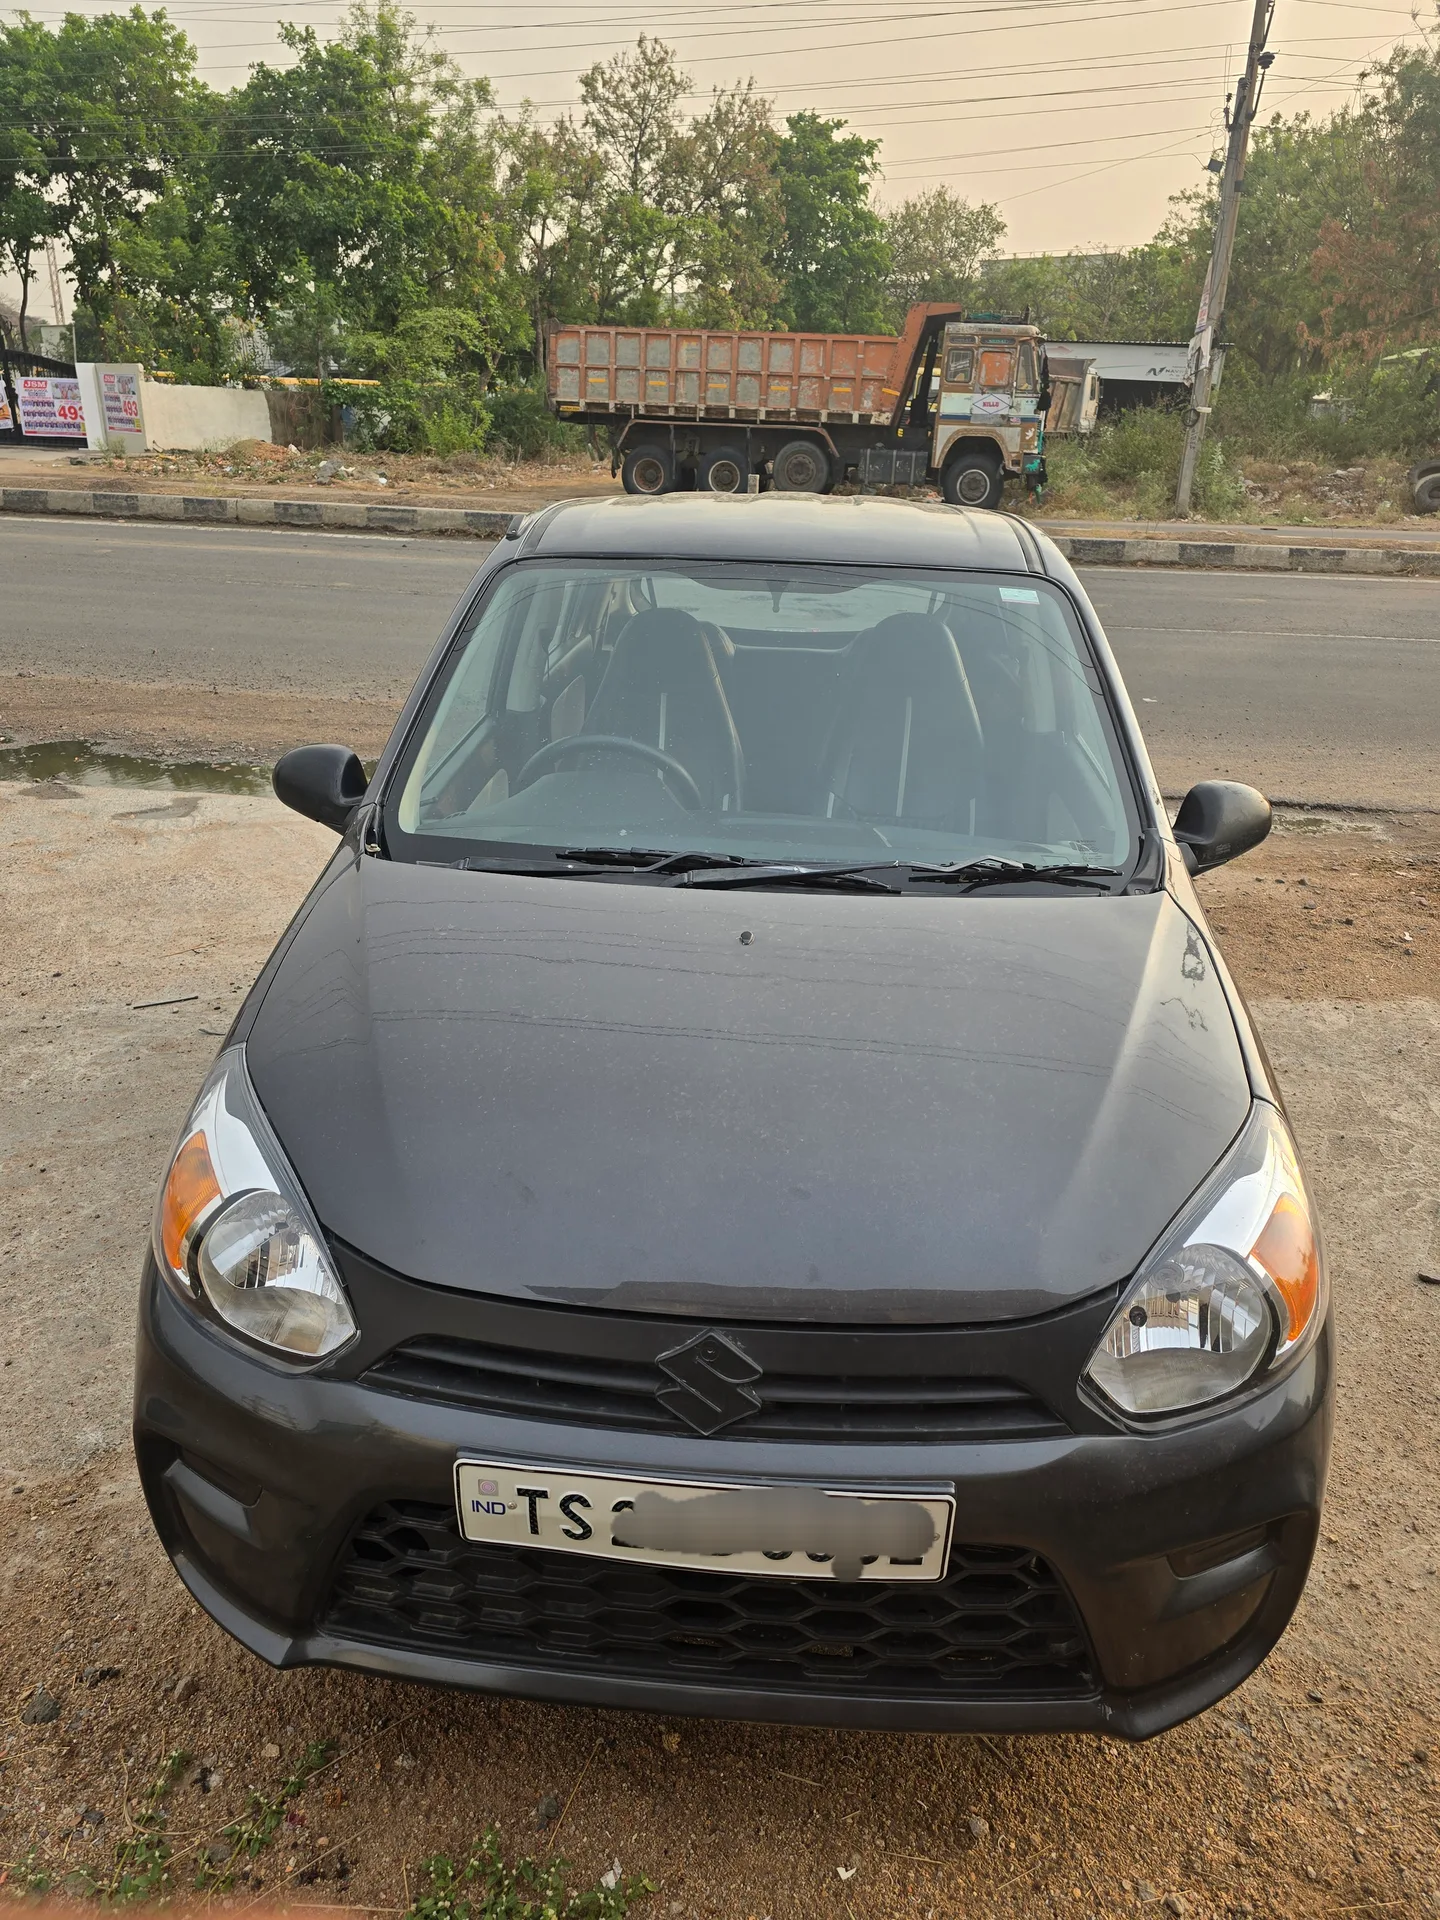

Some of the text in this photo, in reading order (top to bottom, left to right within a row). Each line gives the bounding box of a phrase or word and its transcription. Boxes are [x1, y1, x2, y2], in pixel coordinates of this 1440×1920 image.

[25, 380, 46, 388] JSM
[123, 400, 138, 416] 493
[471, 1500, 506, 1516] IND
